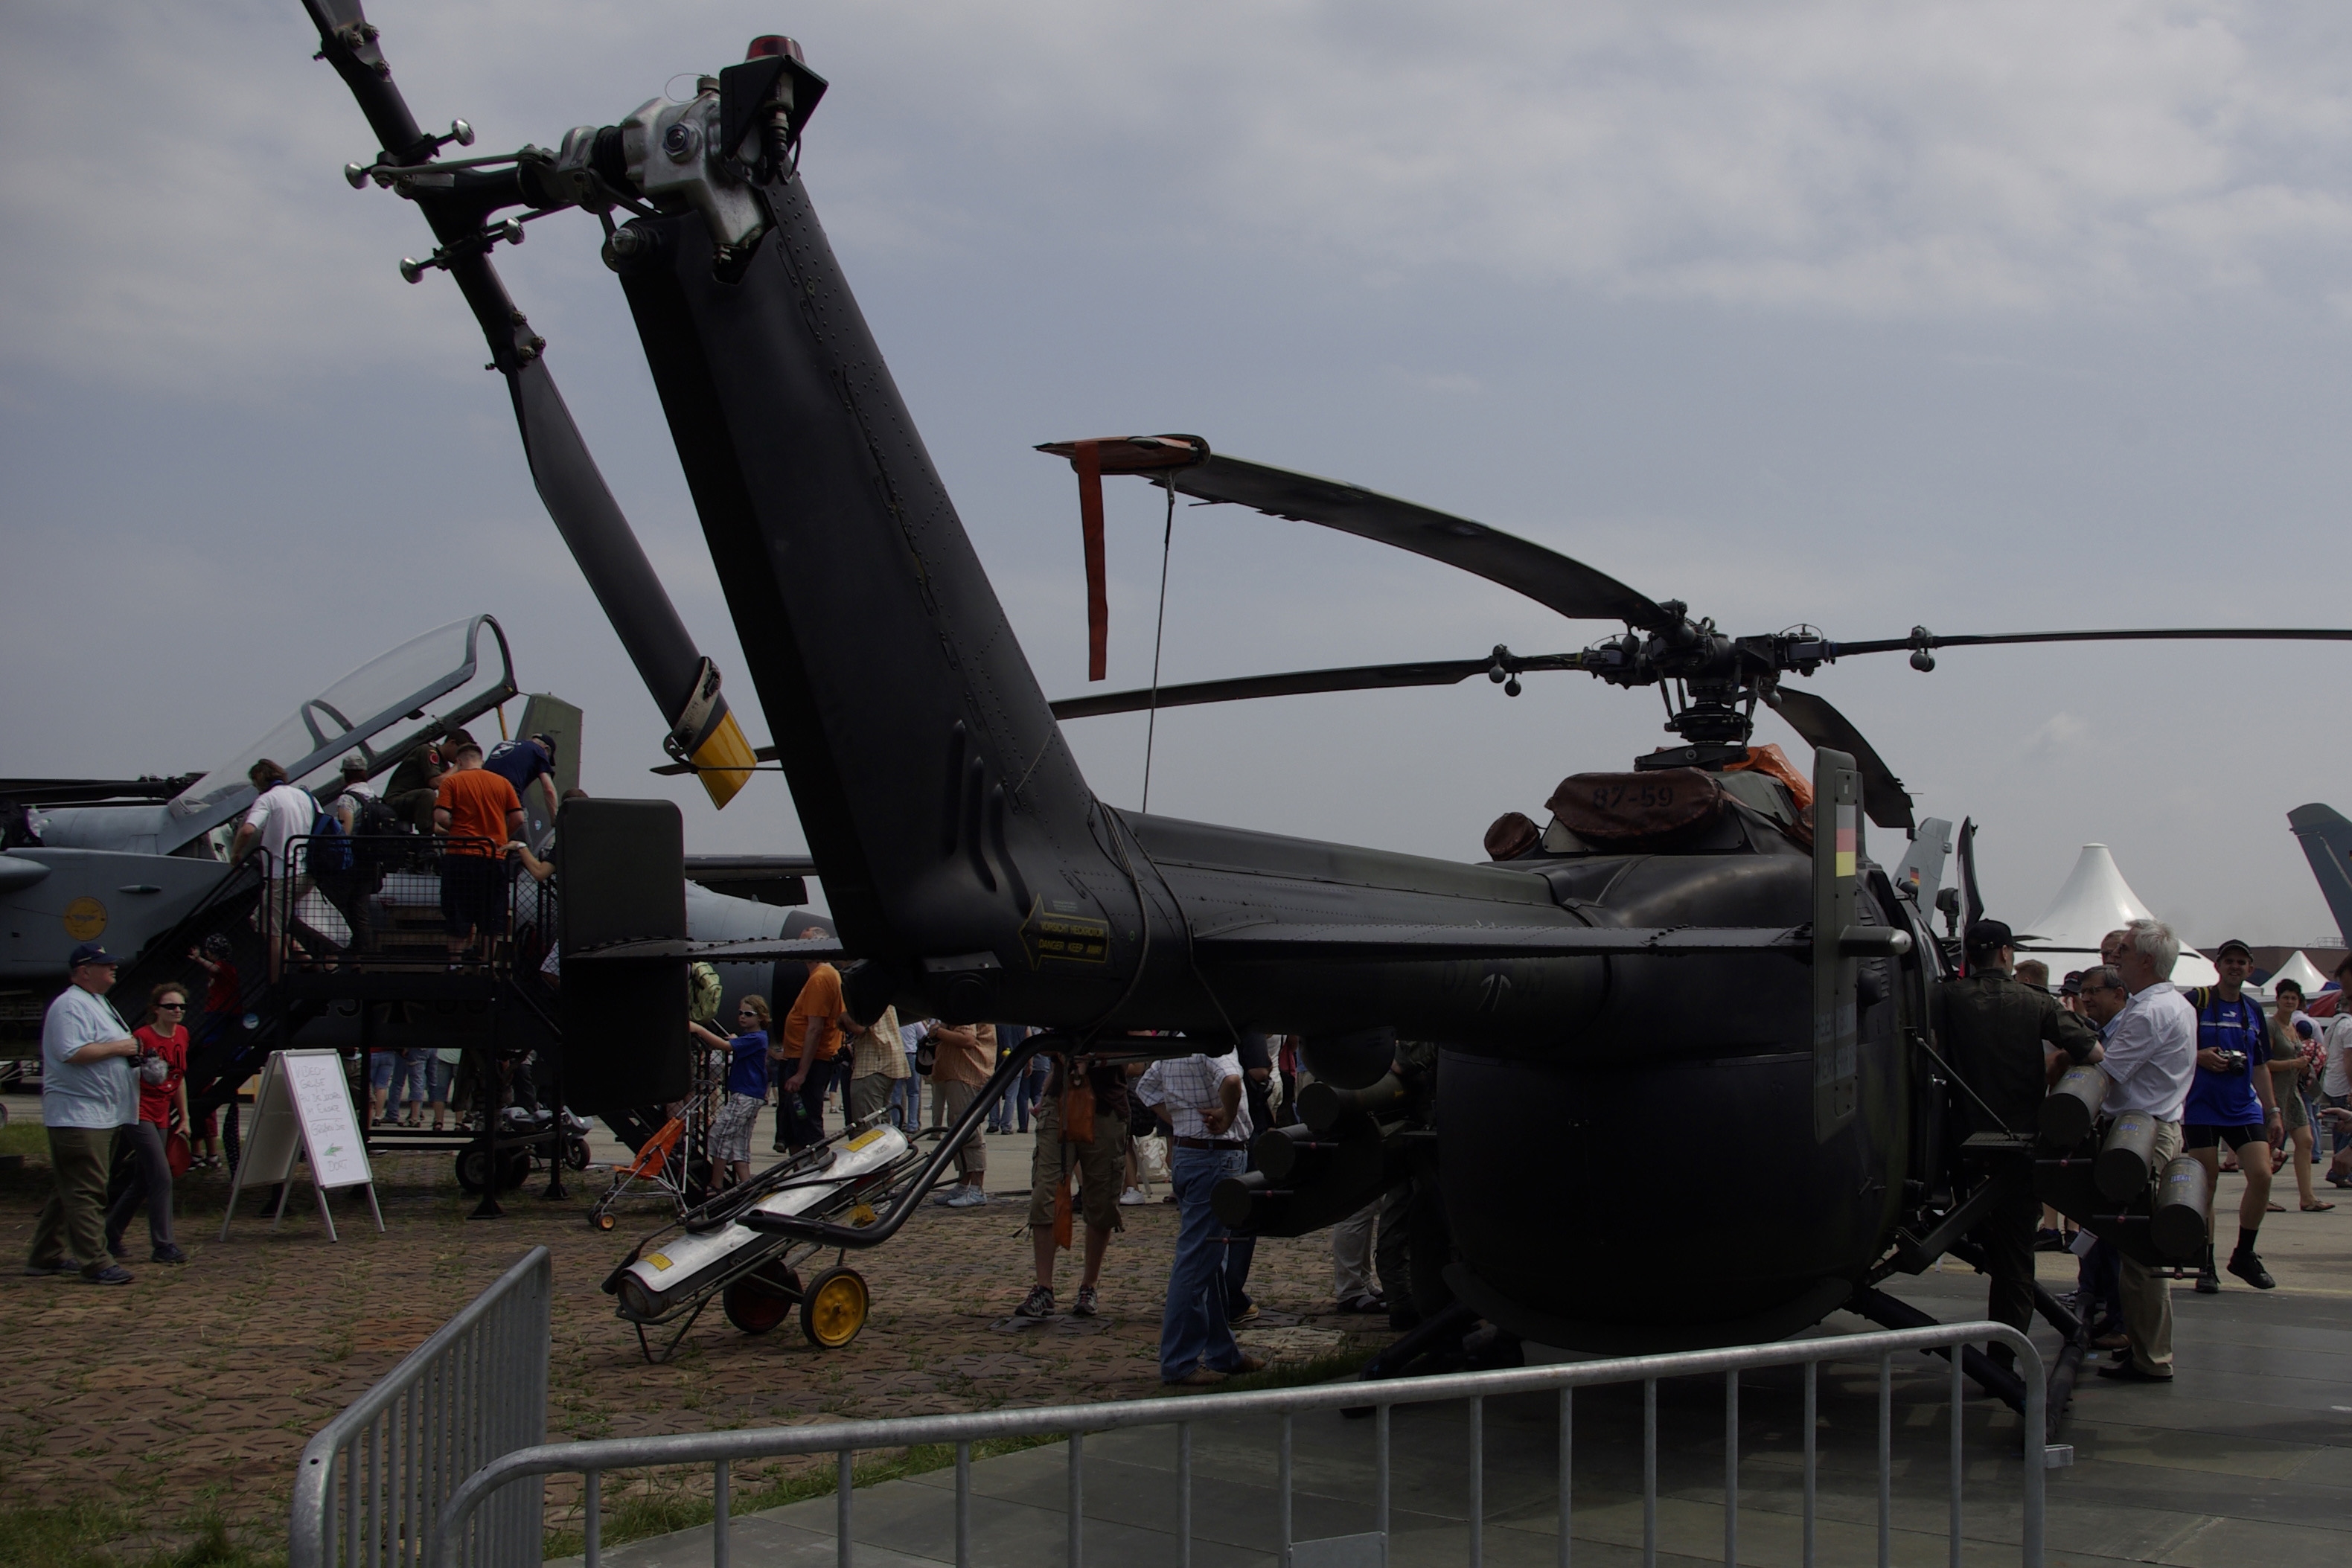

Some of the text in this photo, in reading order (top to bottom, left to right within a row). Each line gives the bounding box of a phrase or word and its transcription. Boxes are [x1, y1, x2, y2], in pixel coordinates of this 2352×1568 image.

[1593, 785, 1673, 810] 87-59
[1040, 921, 1069, 934] VORSICHT
[1038, 938, 1064, 950] DANGER
[1068, 942, 1084, 953] KEEP
